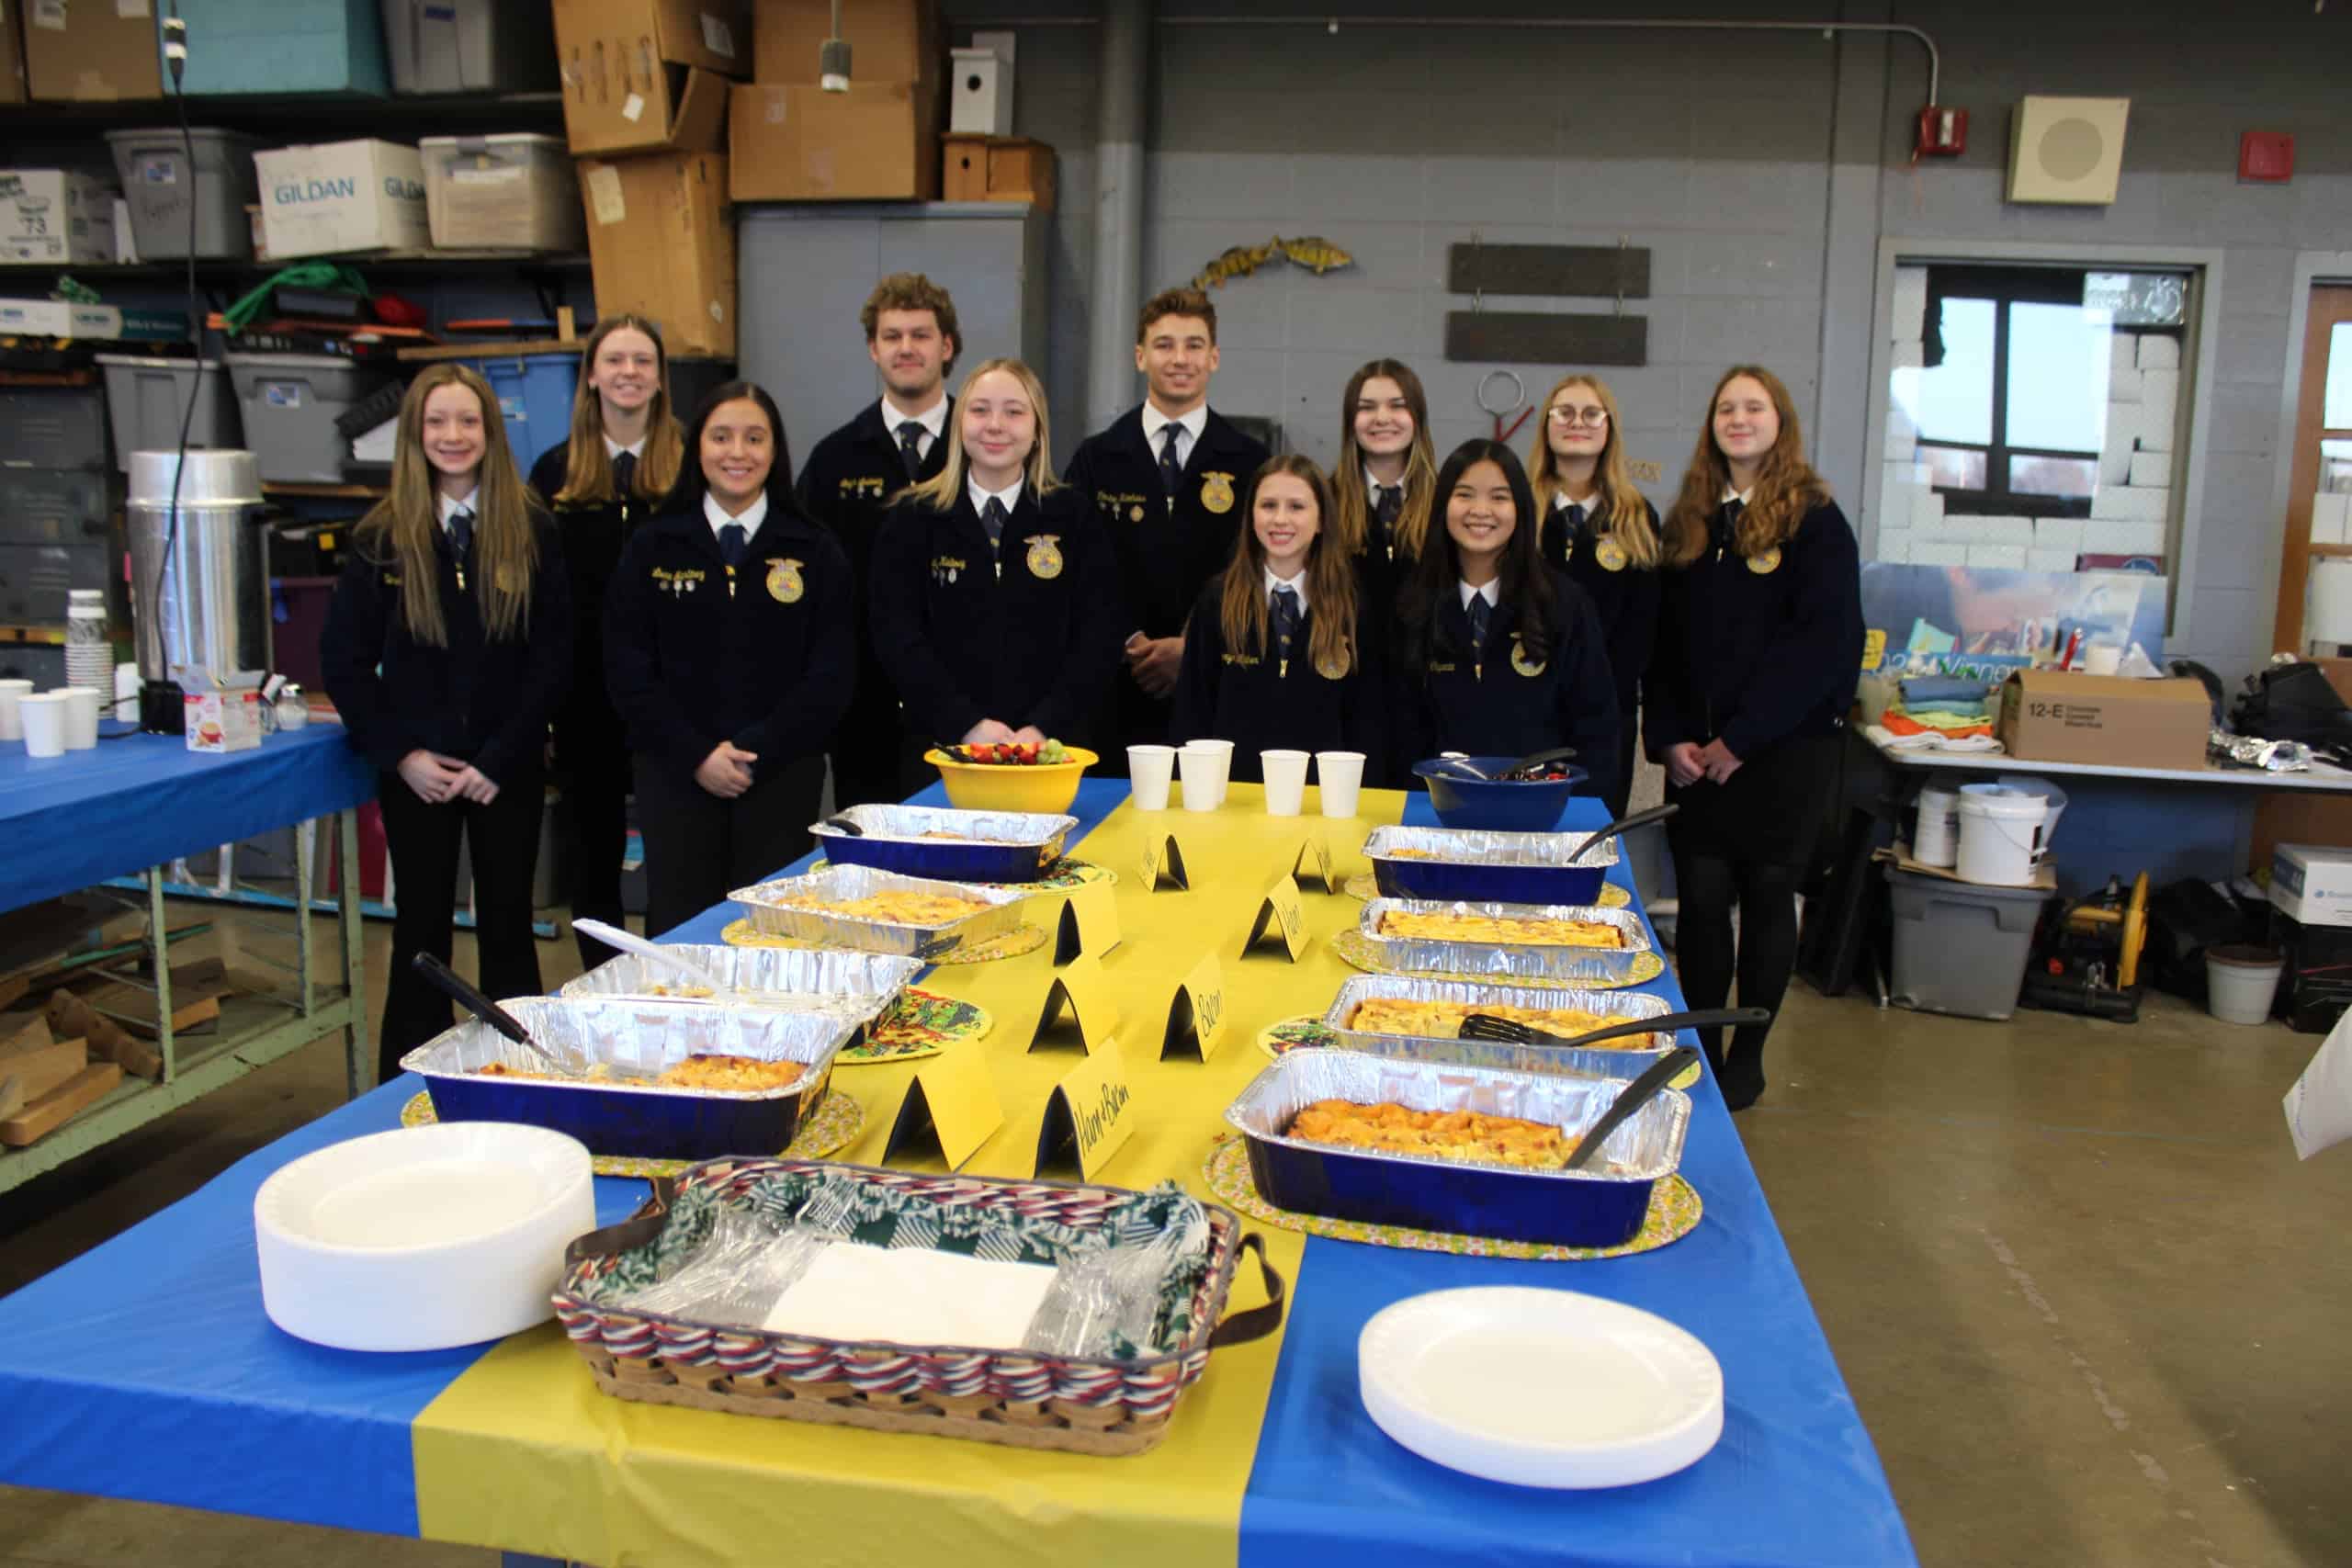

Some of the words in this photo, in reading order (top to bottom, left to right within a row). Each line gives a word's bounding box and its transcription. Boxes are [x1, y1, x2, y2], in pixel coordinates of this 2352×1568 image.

[276, 177, 355, 205] GILDAN
[2030, 703, 2064, 719] 12-E
[1074, 1101, 1104, 1159] Ham
